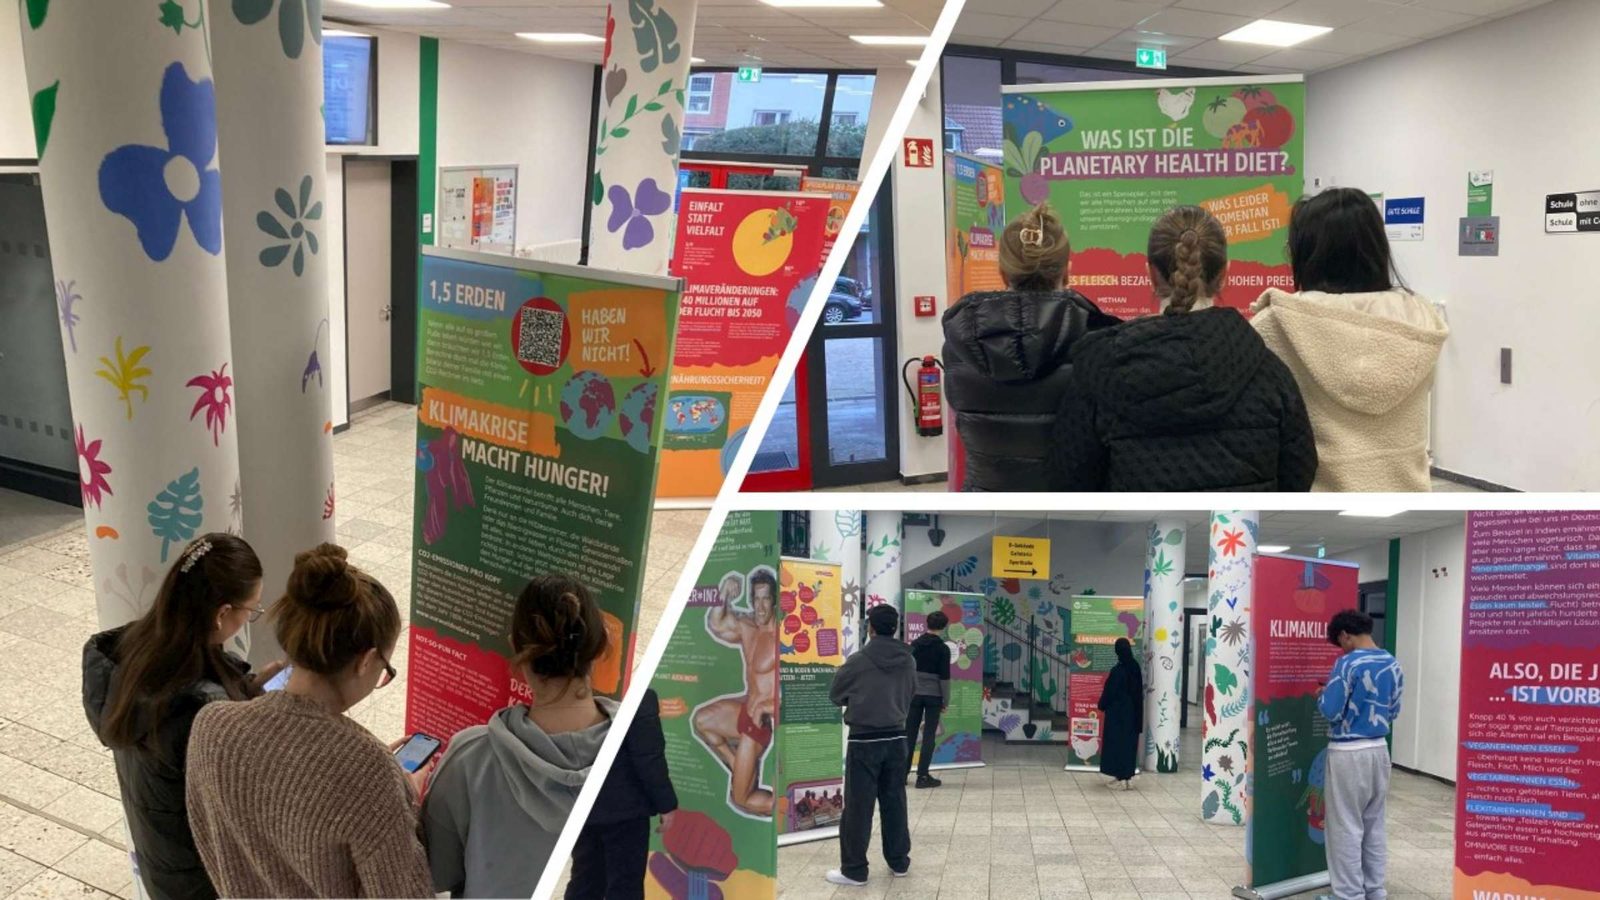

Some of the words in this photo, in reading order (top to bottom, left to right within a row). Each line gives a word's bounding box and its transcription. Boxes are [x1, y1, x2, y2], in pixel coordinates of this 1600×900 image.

[1081, 129, 1122, 150] WAS
[1129, 128, 1157, 149] IST
[1162, 127, 1194, 148] DIE
[1040, 154, 1149, 177] PLANETARY
[1155, 152, 1228, 174] HEALTH
[1235, 151, 1289, 172] DIET?
[689, 201, 724, 212] EINFALT
[1208, 198, 1231, 212] WAS
[1233, 192, 1269, 209] LEIDER
[1550, 200, 1574, 209] Schule
[687, 213, 714, 224] STATT
[1550, 218, 1573, 226] Schule
[1580, 217, 1591, 225] mit
[686, 225, 725, 236] VIELFALT
[1235, 222, 1260, 235] FALL
[1262, 218, 1280, 231] IST!
[1080, 274, 1119, 286] FLEISCH
[1228, 275, 1263, 286] HOHEN
[1266, 275, 1295, 286] PREIS
[430, 279, 451, 303] 1,5
[455, 284, 506, 312] ERDEN
[695, 296, 740, 306] MILLIONEN
[741, 297, 759, 306] AUF
[581, 307, 627, 326] HABEN
[694, 307, 726, 317] FLUCHT
[727, 308, 740, 318] BIS
[742, 308, 762, 318] 2050
[582, 327, 610, 345] WIR
[582, 345, 630, 363] NICHT!
[671, 374, 766, 386] NÄHRUNGSSICHERHEIT?
[428, 399, 530, 445] KLIMAKRISE
[461, 439, 520, 475] MACHT
[524, 457, 610, 498] HUNGER!
[1492, 537, 1533, 545] Menschen
[1559, 609, 1598, 617] hunderte
[451, 648, 468, 661] FACT
[1489, 662, 1543, 682] ALSO,
[1550, 663, 1583, 681] DIE
[1512, 685, 1541, 702] IST
[1535, 715, 1556, 723] euch
[1523, 764, 1544, 772] Milch
[1474, 853, 1503, 862] einfach
